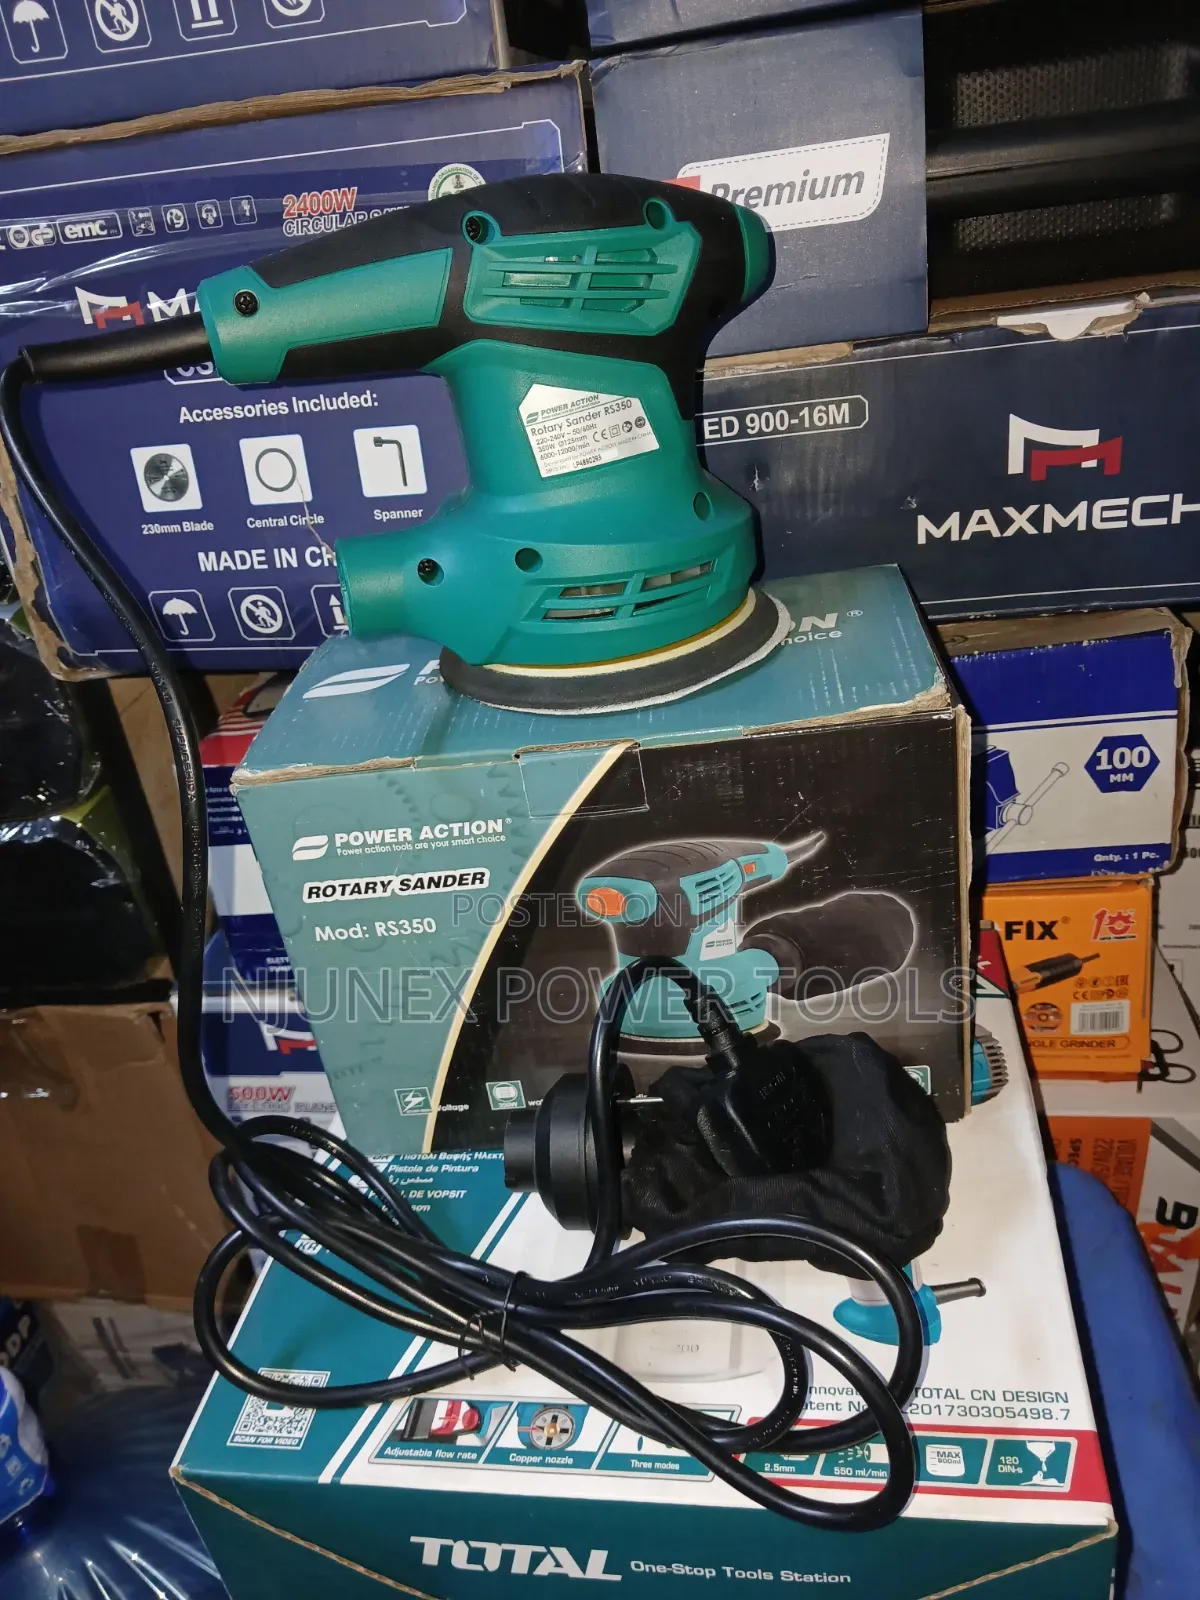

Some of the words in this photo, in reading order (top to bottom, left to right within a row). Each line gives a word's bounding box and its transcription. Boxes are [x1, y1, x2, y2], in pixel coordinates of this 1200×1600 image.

[710, 168, 866, 211] Premium
[282, 187, 358, 219] 2400W
[64, 219, 108, 239] emc
[179, 399, 289, 424] Accessories
[292, 391, 379, 413] Included:
[541, 404, 569, 416] POWER
[570, 395, 600, 408] ACTION
[531, 422, 564, 437] Rotary
[566, 410, 602, 427] Sander
[604, 399, 633, 416] RS350
[702, 415, 740, 440] ED
[745, 402, 851, 433] 900-16M
[536, 433, 565, 446] 220-240V
[246, 514, 288, 528] Central
[289, 513, 325, 527] Circle
[373, 507, 424, 522] Spanner
[141, 522, 181, 535] 230mm
[182, 520, 214, 532] Blade
[197, 549, 269, 572] MADE
[273, 547, 299, 570] IN
[414, 676, 444, 685] PO
[1095, 745, 1151, 771] 100
[1109, 773, 1134, 783] MM
[335, 827, 412, 847] POWER
[419, 818, 503, 840] ACTION
[336, 846, 363, 857] Power
[364, 844, 391, 854] action
[392, 842, 413, 852] tools
[415, 841, 429, 850] are
[430, 840, 450, 851] your
[451, 836, 475, 847] smart
[476, 833, 507, 844] choice
[1141, 851, 1160, 860] Pc.
[306, 878, 394, 900] ROTARY
[397, 870, 487, 892] SANDER
[315, 921, 370, 942] Mod:
[374, 916, 437, 938] RS350
[1004, 919, 1059, 941] FIX
[1060, 1039, 1117, 1049] GRINDER
[388, 1164, 423, 1174] Pistola
[425, 1163, 439, 1173] de
[441, 1164, 479, 1173] Pintura
[409, 1189, 424, 1199] DE
[427, 1189, 467, 1199] VOPSIT
[914, 1387, 964, 1401] TOTAL
[970, 1389, 997, 1402] CN
[1002, 1390, 1069, 1405] DESIGN
[901, 1402, 1071, 1421] 201730305498.7
[232, 1435, 256, 1443] SCAN
[256, 1436, 274, 1444] FOR
[274, 1437, 300, 1446] VIDEO
[384, 1446, 433, 1459] Adjustable
[434, 1448, 455, 1459] flow
[457, 1450, 478, 1460] rate
[509, 1452, 543, 1465] Copper
[544, 1454, 574, 1465] nozzle
[936, 1450, 961, 1459] MAX
[999, 1455, 1019, 1465] 120
[630, 1458, 653, 1469] Three
[654, 1461, 680, 1471] modes
[764, 1462, 796, 1473] 2.5mm
[834, 1466, 853, 1477] 550
[854, 1467, 888, 1479] ml/min
[410, 1535, 623, 1581] TOTAL
[630, 1560, 717, 1580] One-Stop
[721, 1565, 774, 1581] Tools
[779, 1569, 852, 1584] Station
